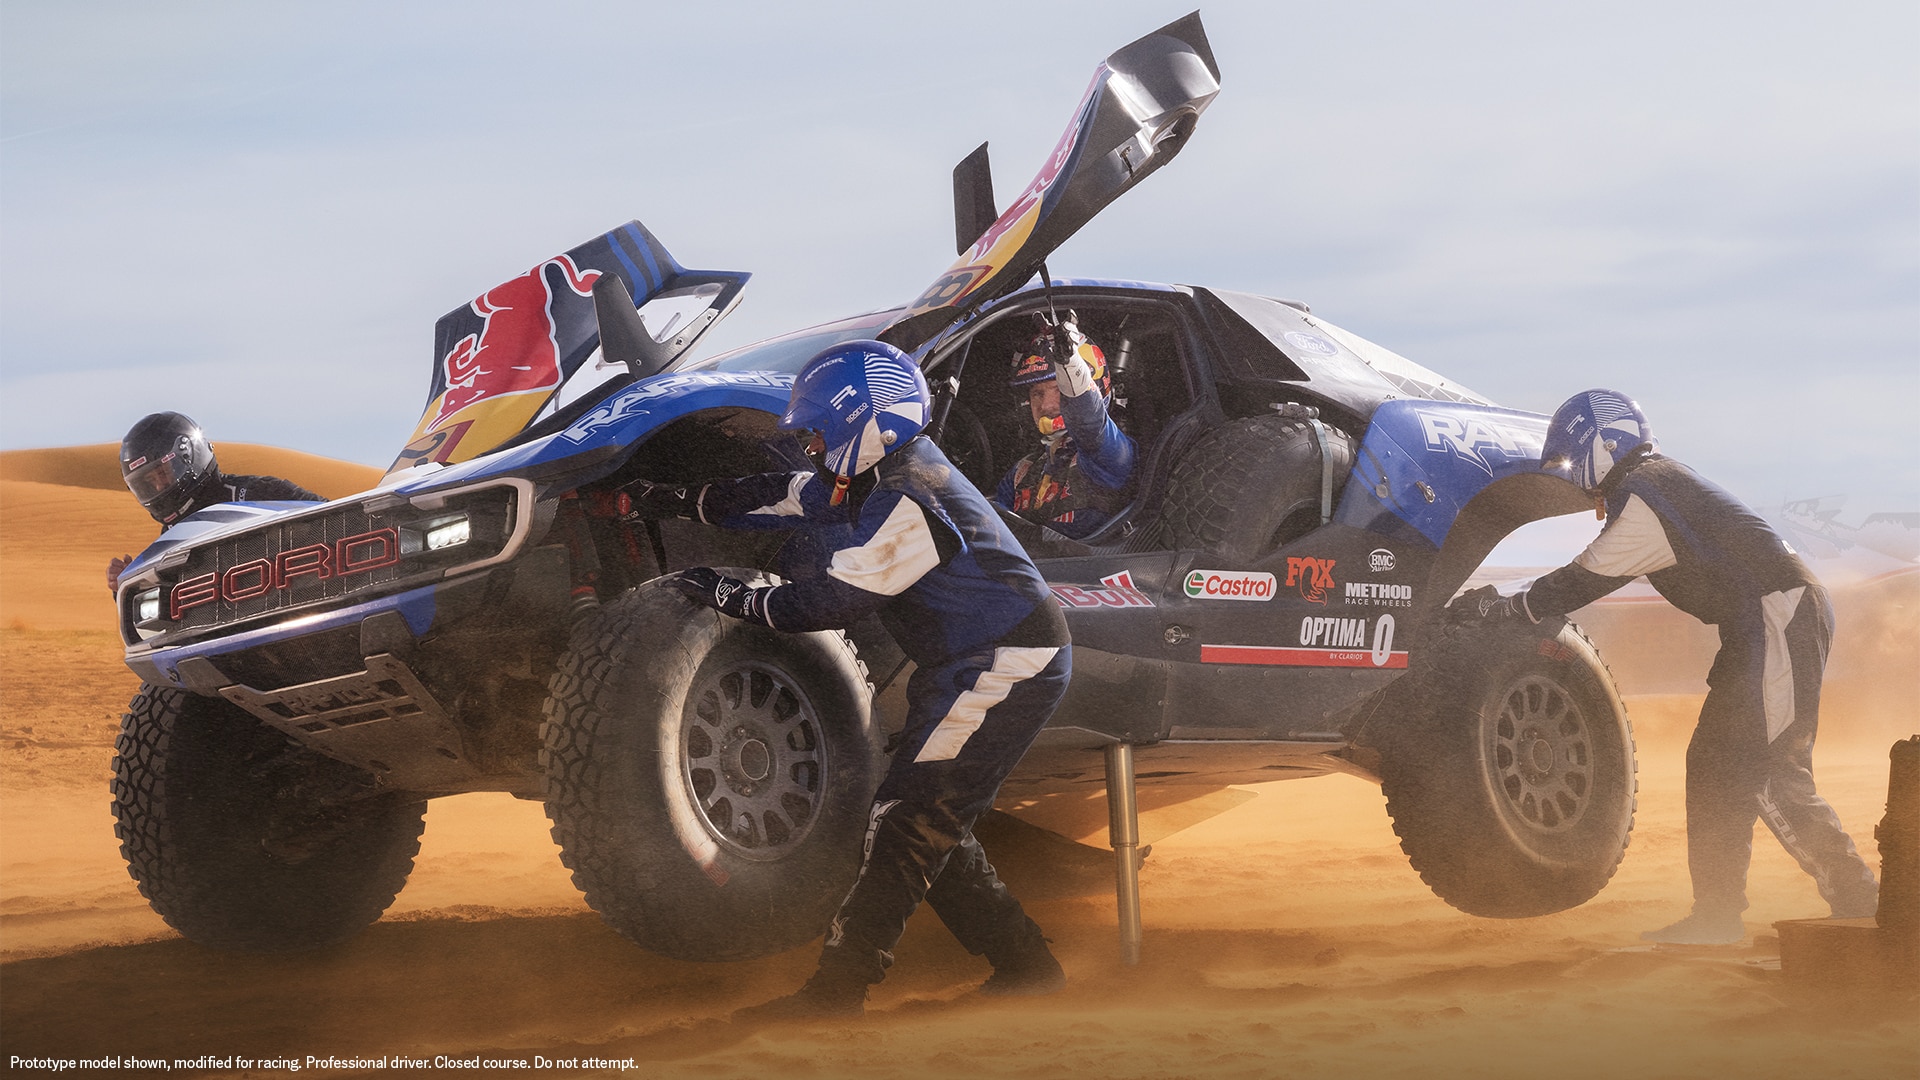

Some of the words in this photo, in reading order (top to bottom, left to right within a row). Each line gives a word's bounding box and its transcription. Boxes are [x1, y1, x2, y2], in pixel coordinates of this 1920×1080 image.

[845, 402, 869, 424] sparco
[1371, 554, 1394, 567] BMC
[170, 527, 399, 621] FORD
[1286, 556, 1336, 598] FOX
[1205, 574, 1273, 597] Castrol
[1345, 582, 1412, 600] METHOD
[1345, 598, 1369, 606] RACE
[1373, 599, 1412, 608] WHEELS
[1300, 616, 1366, 647] OPTIMA
[1329, 652, 1338, 660] BY
